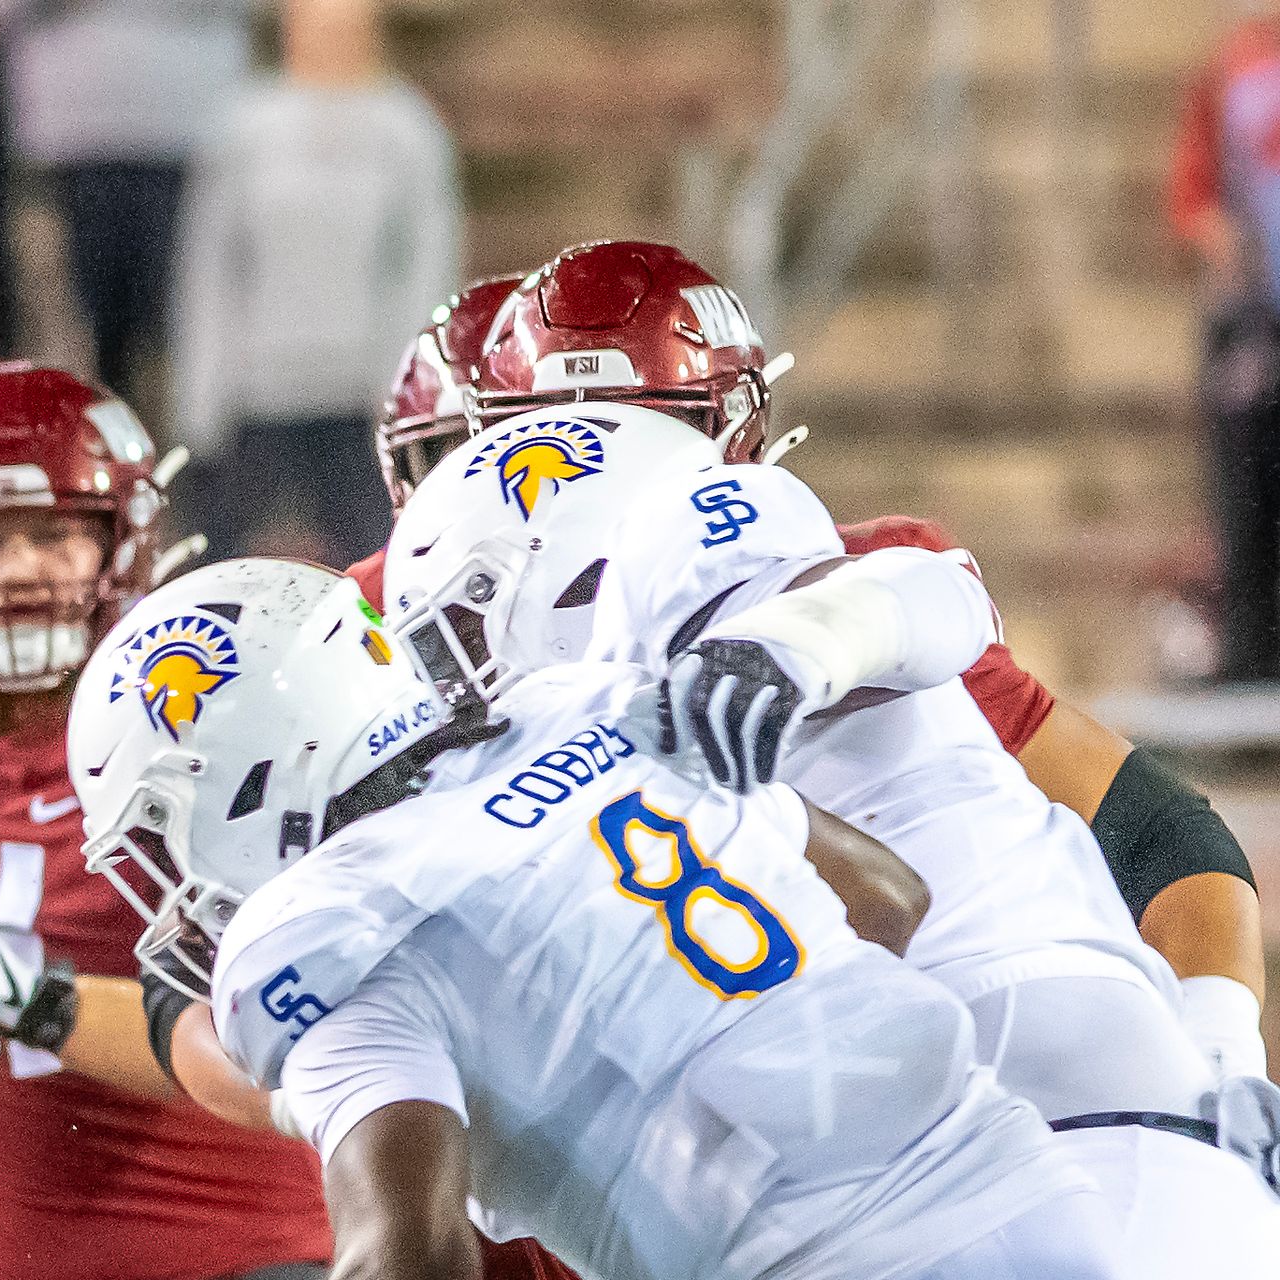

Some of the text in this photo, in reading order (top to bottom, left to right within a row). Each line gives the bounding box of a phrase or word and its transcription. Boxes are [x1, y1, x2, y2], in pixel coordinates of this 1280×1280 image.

[563, 355, 600, 377] WSU
[368, 713, 409, 757] SAN
[588, 786, 807, 1001] 8
